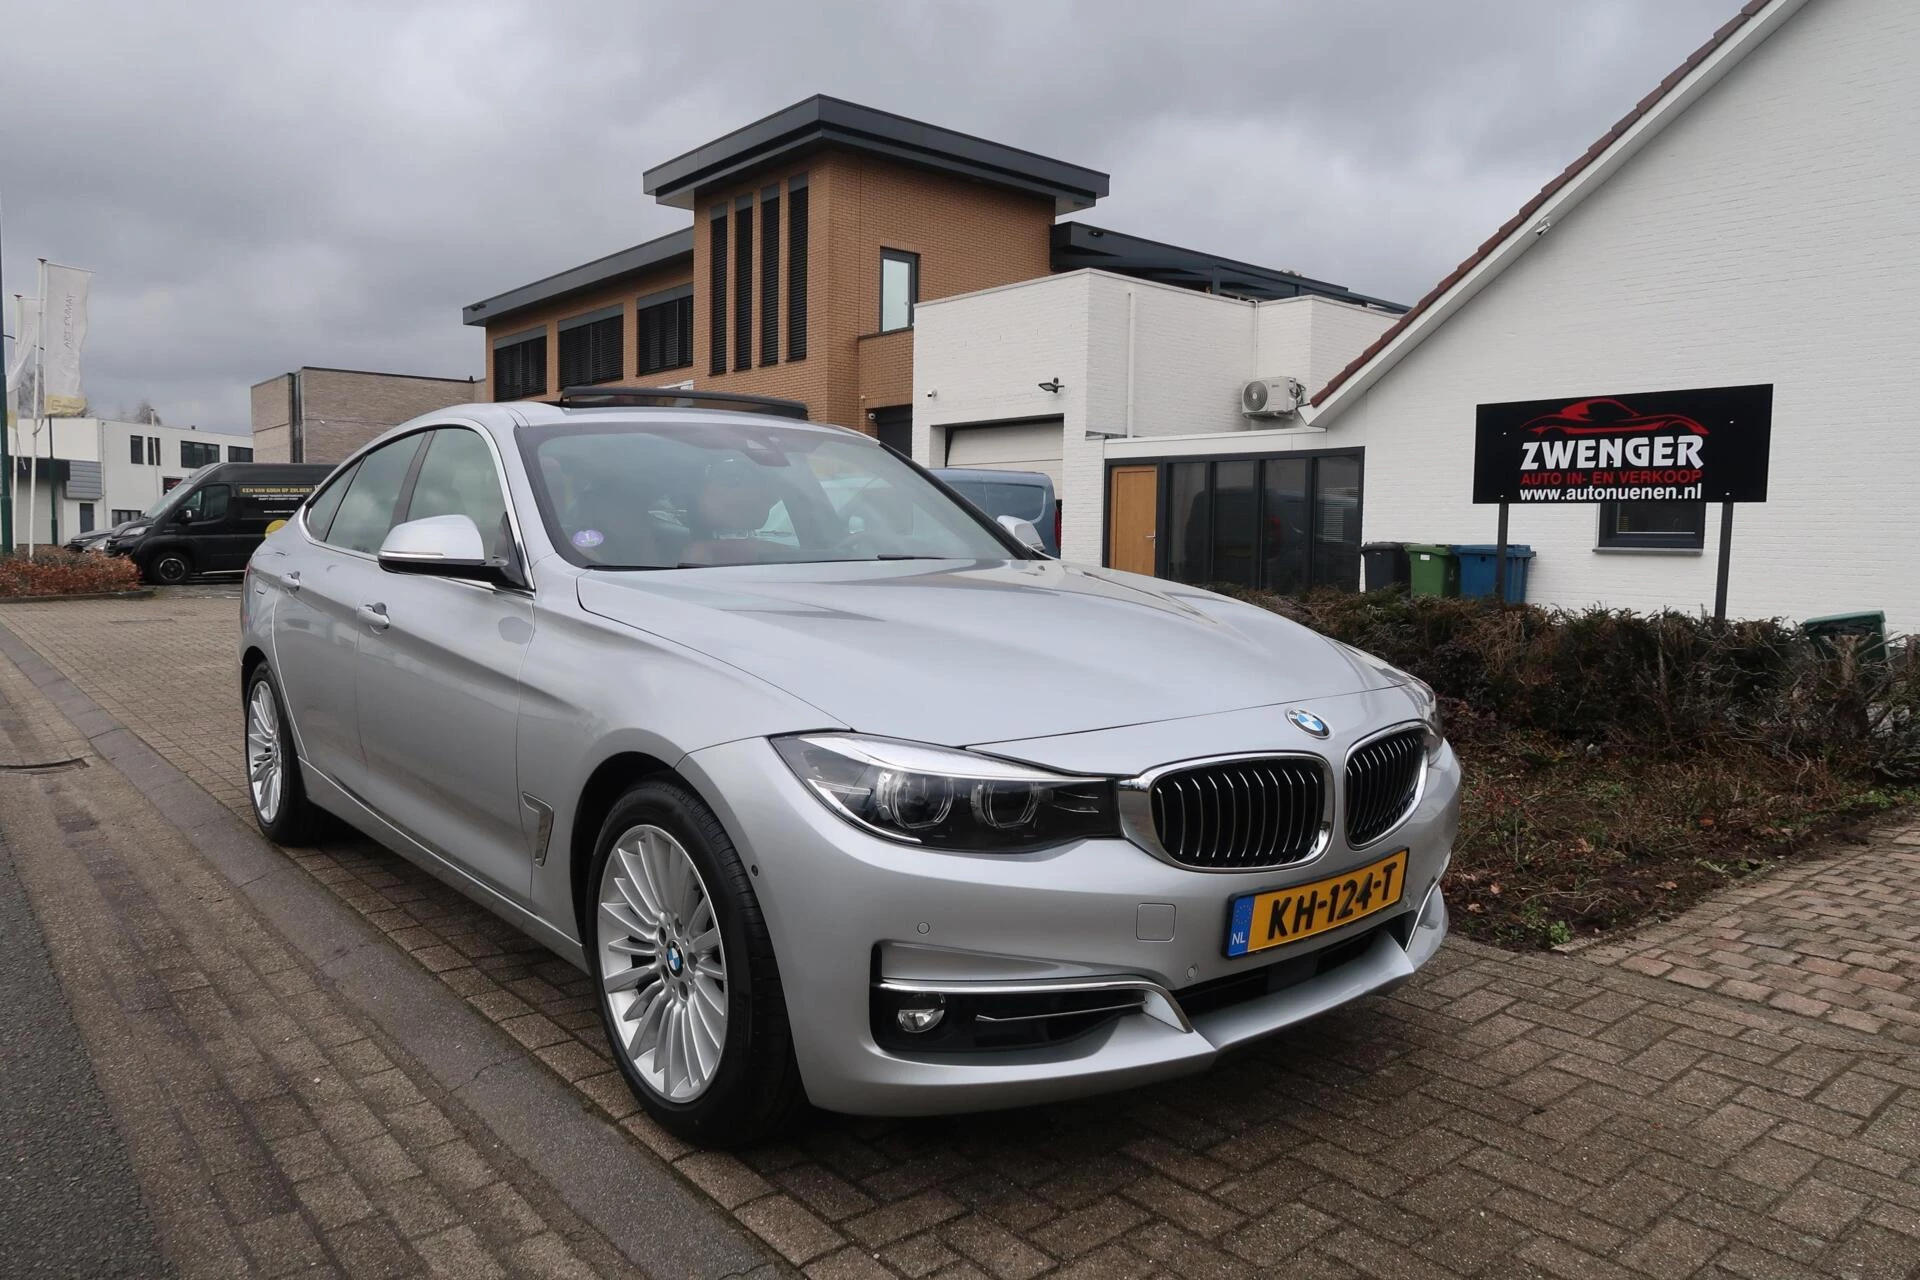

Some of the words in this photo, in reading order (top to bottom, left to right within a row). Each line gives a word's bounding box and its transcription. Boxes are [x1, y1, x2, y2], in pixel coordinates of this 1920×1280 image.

[1519, 434, 1704, 471] ZWENGER
[1520, 471, 1562, 486] AUTO
[1566, 471, 1588, 485] IN-
[1592, 470, 1618, 485] EN
[1618, 469, 1703, 485] VERKOOP
[1519, 483, 1702, 501] www.autonuenen.nl
[1267, 861, 1398, 940] KH-124-T
[1231, 932, 1246, 946] NL
